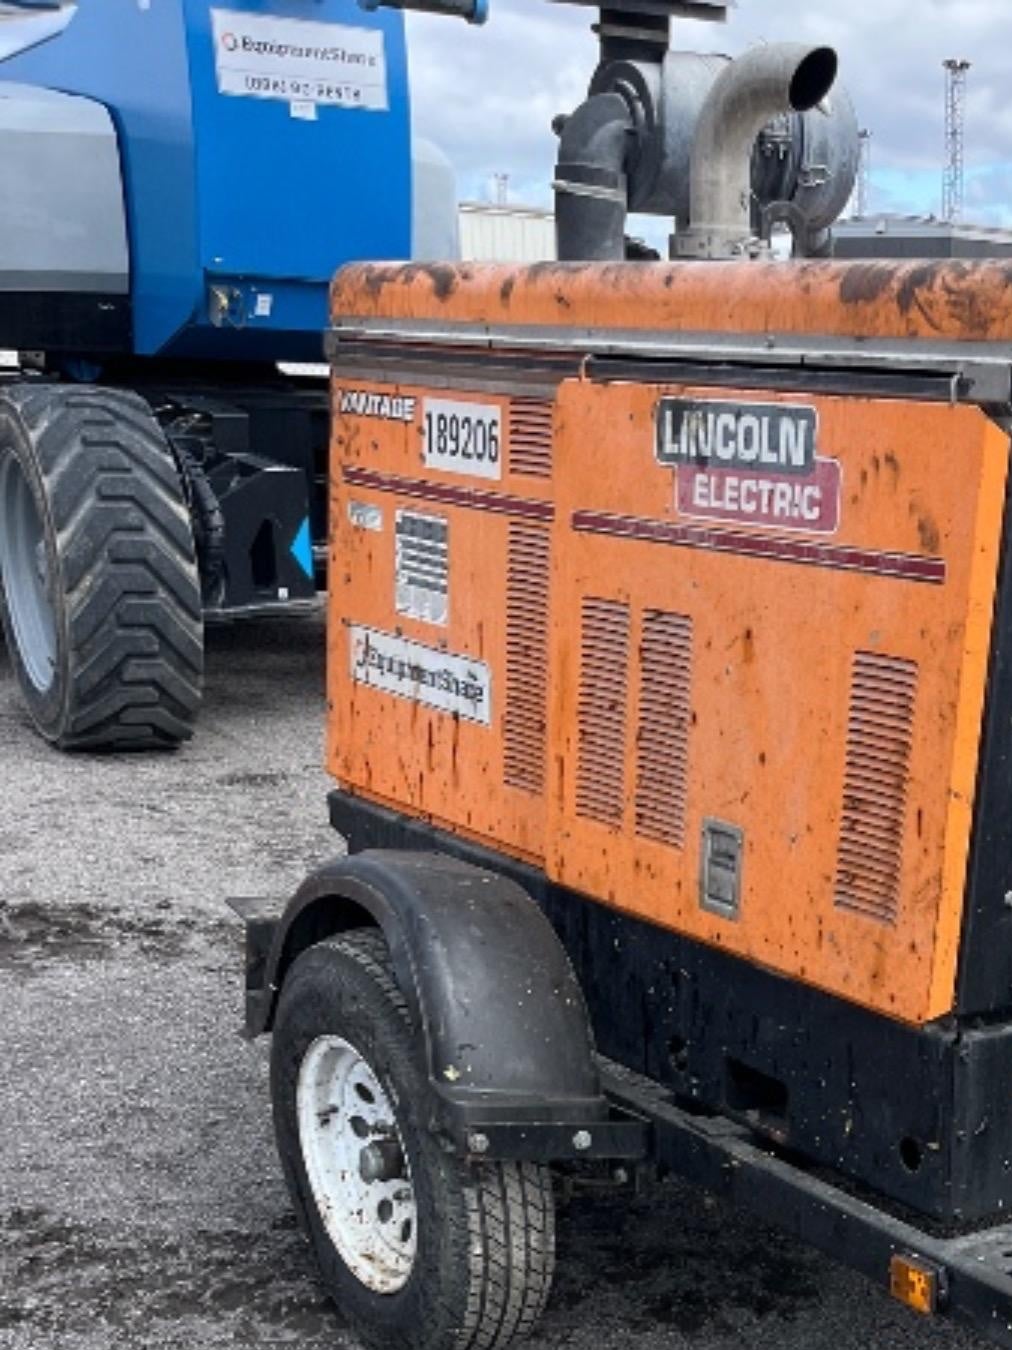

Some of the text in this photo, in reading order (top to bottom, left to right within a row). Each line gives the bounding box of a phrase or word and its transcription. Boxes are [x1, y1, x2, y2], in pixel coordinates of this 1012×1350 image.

[425, 411, 499, 463] 189206
[663, 410, 808, 466] LINCOLN
[692, 473, 821, 520] ELECTRIC
